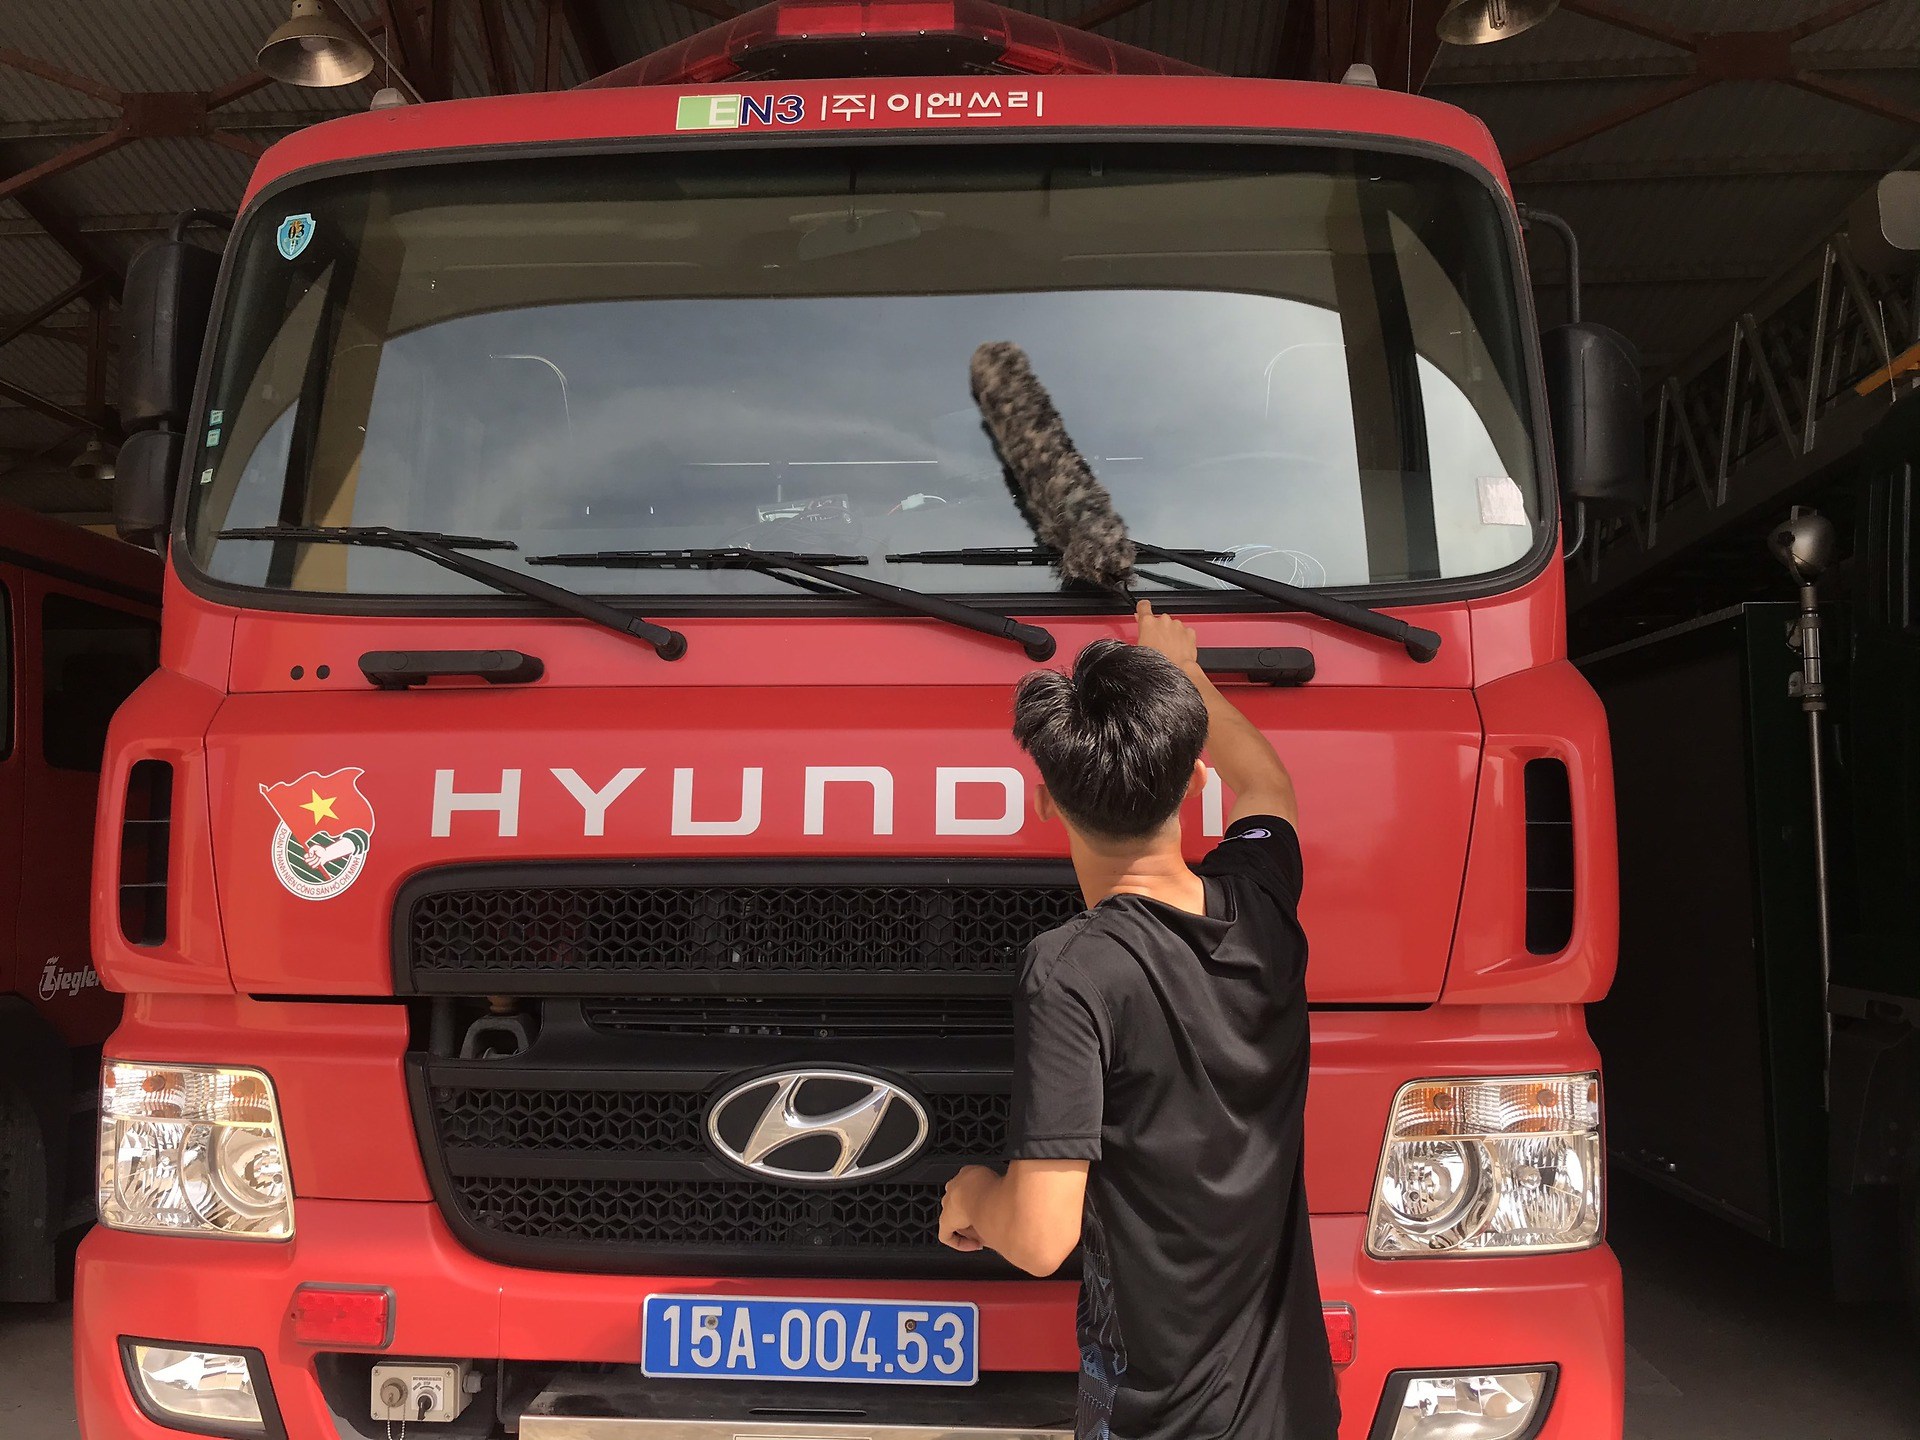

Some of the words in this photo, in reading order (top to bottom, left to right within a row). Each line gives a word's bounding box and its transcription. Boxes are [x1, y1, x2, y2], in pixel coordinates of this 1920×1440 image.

[708, 95, 805, 126] EN3
[887, 91, 1043, 119] 이엔쓰리
[288, 224, 304, 239] 03
[430, 766, 1223, 837] HYUNDI
[348, 857, 360, 874] MINH
[663, 1305, 966, 1374] 15A-004.53
